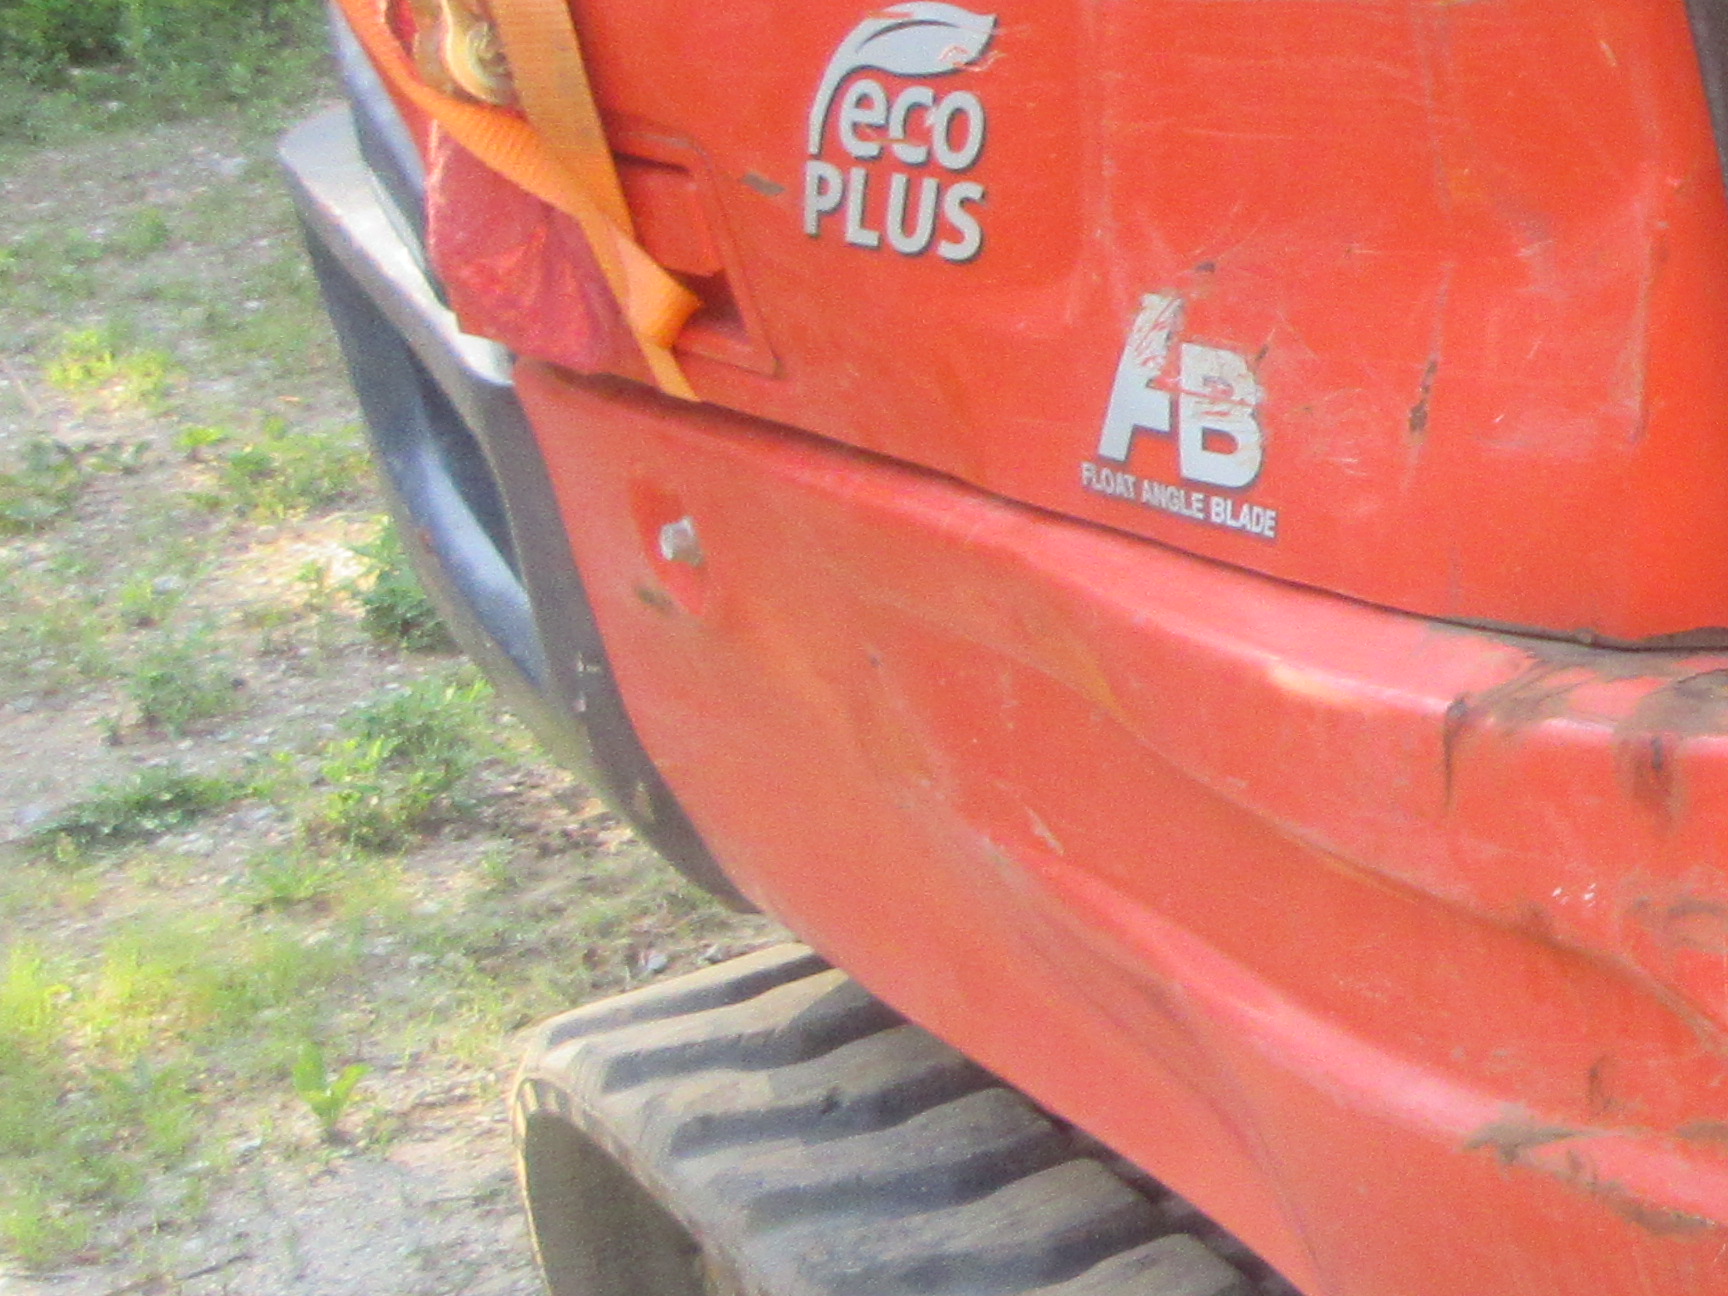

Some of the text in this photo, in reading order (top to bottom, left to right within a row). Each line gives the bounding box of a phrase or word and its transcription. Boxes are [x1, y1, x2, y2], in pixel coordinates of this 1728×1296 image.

[838, 77, 988, 172] eco
[803, 159, 988, 264] PLUS
[1082, 461, 1276, 538] FLOAT ANGLE BLADE
